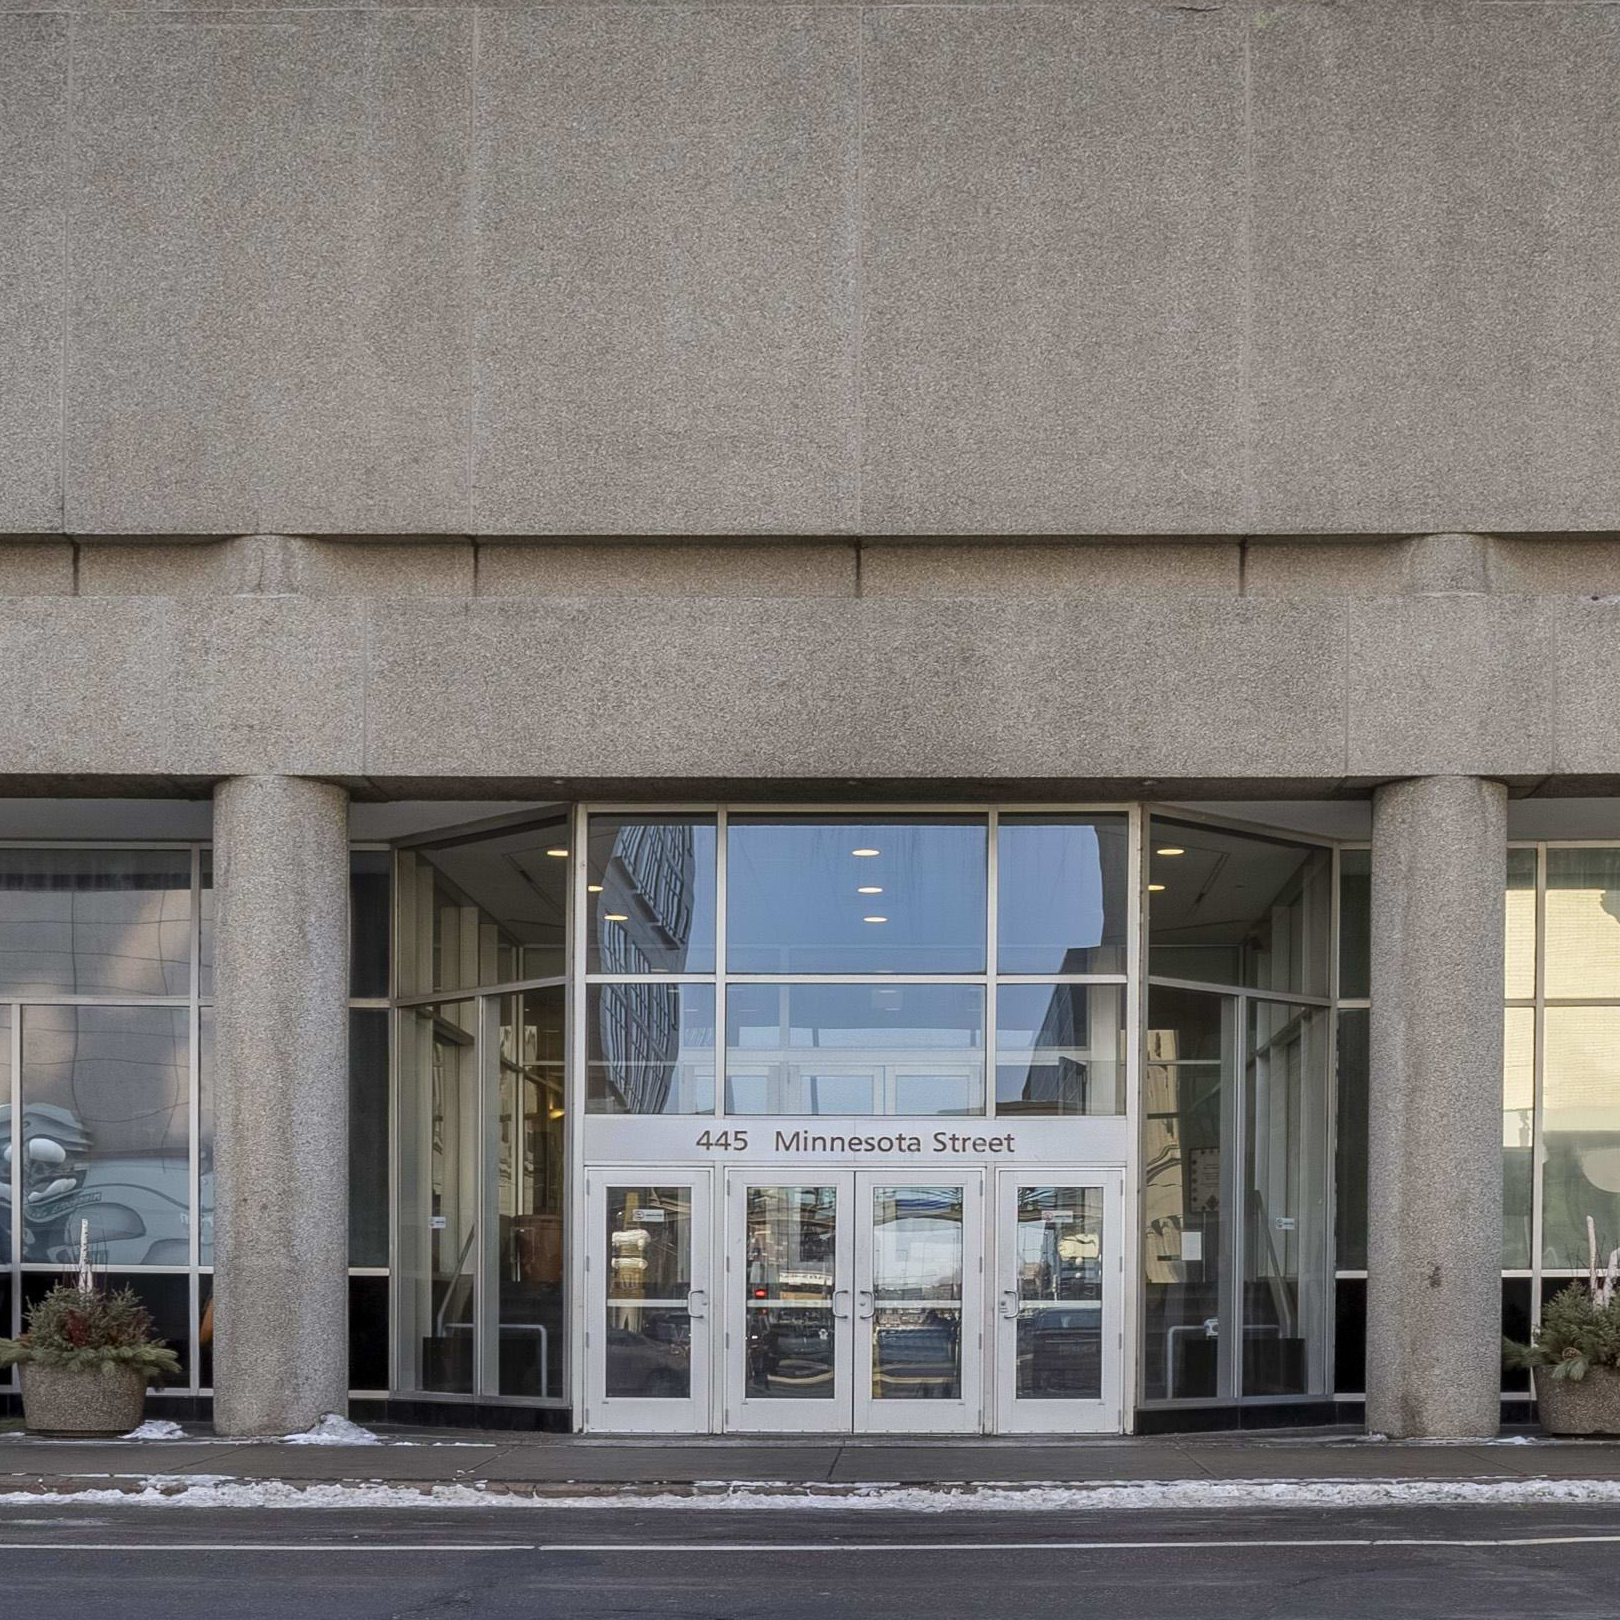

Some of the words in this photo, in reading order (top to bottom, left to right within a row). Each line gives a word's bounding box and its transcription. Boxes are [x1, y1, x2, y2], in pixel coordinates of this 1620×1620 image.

[696, 1130, 748, 1152] 445
[775, 1130, 921, 1153] Minnesota
[933, 1131, 1015, 1153] Street
